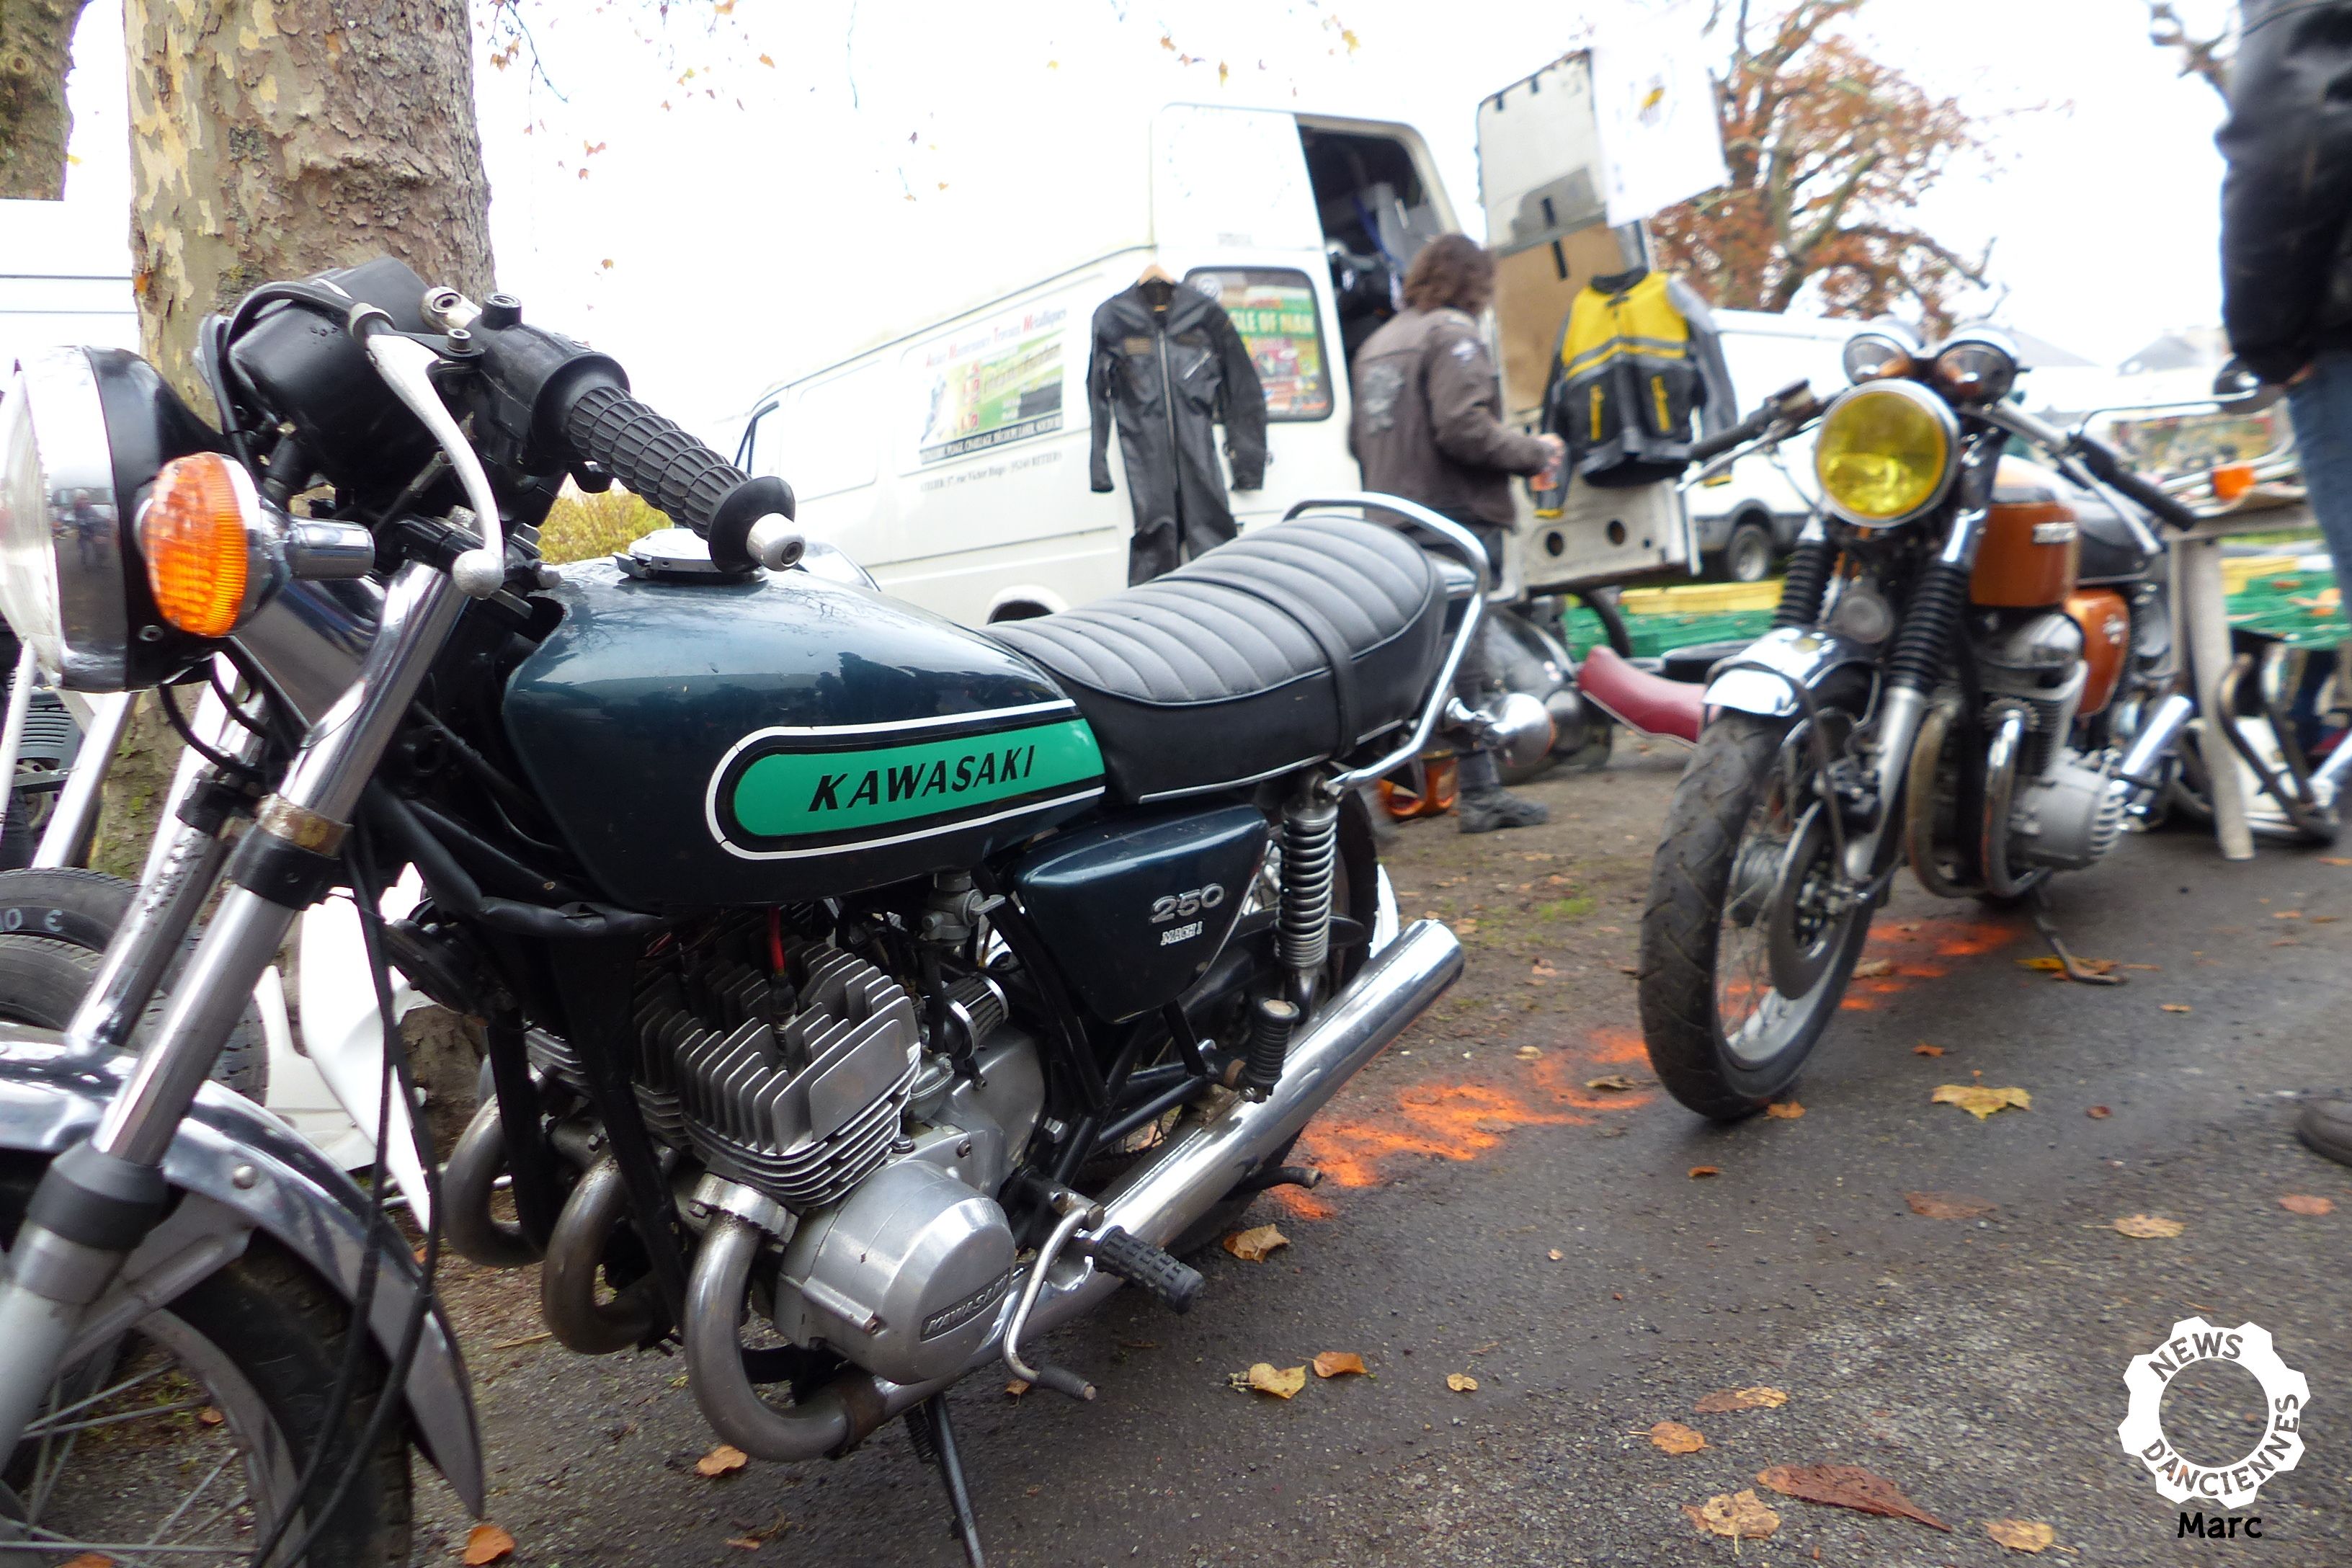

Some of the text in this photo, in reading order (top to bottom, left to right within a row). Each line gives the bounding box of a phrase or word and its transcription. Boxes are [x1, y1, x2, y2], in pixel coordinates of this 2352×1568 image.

[808, 745, 1035, 811] KAWASAKI
[1152, 883, 1224, 923] 250
[925, 1273, 1008, 1335] KAWASAKI
